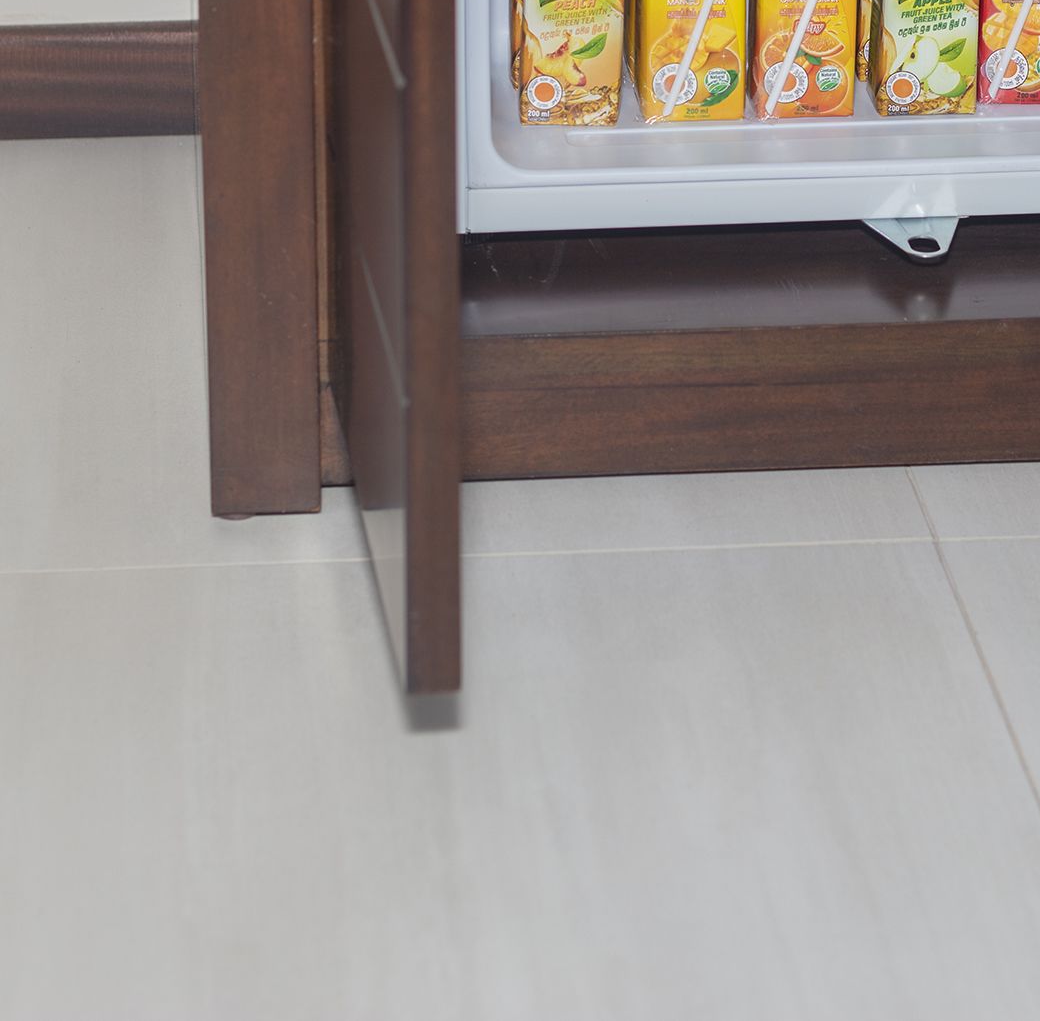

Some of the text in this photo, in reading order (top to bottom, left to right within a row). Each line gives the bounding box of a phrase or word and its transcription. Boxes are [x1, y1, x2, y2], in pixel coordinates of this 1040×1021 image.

[543, 12, 563, 21] FRUIT
[588, 7, 608, 16] WITH
[901, 3, 965, 19] FRUIT JUICE WITH
[555, 16, 595, 27] GREEN TEA
[913, 12, 953, 24] GREEN TEA
[527, 109, 550, 117] 200 ml
[888, 104, 910, 112] 200 ml
